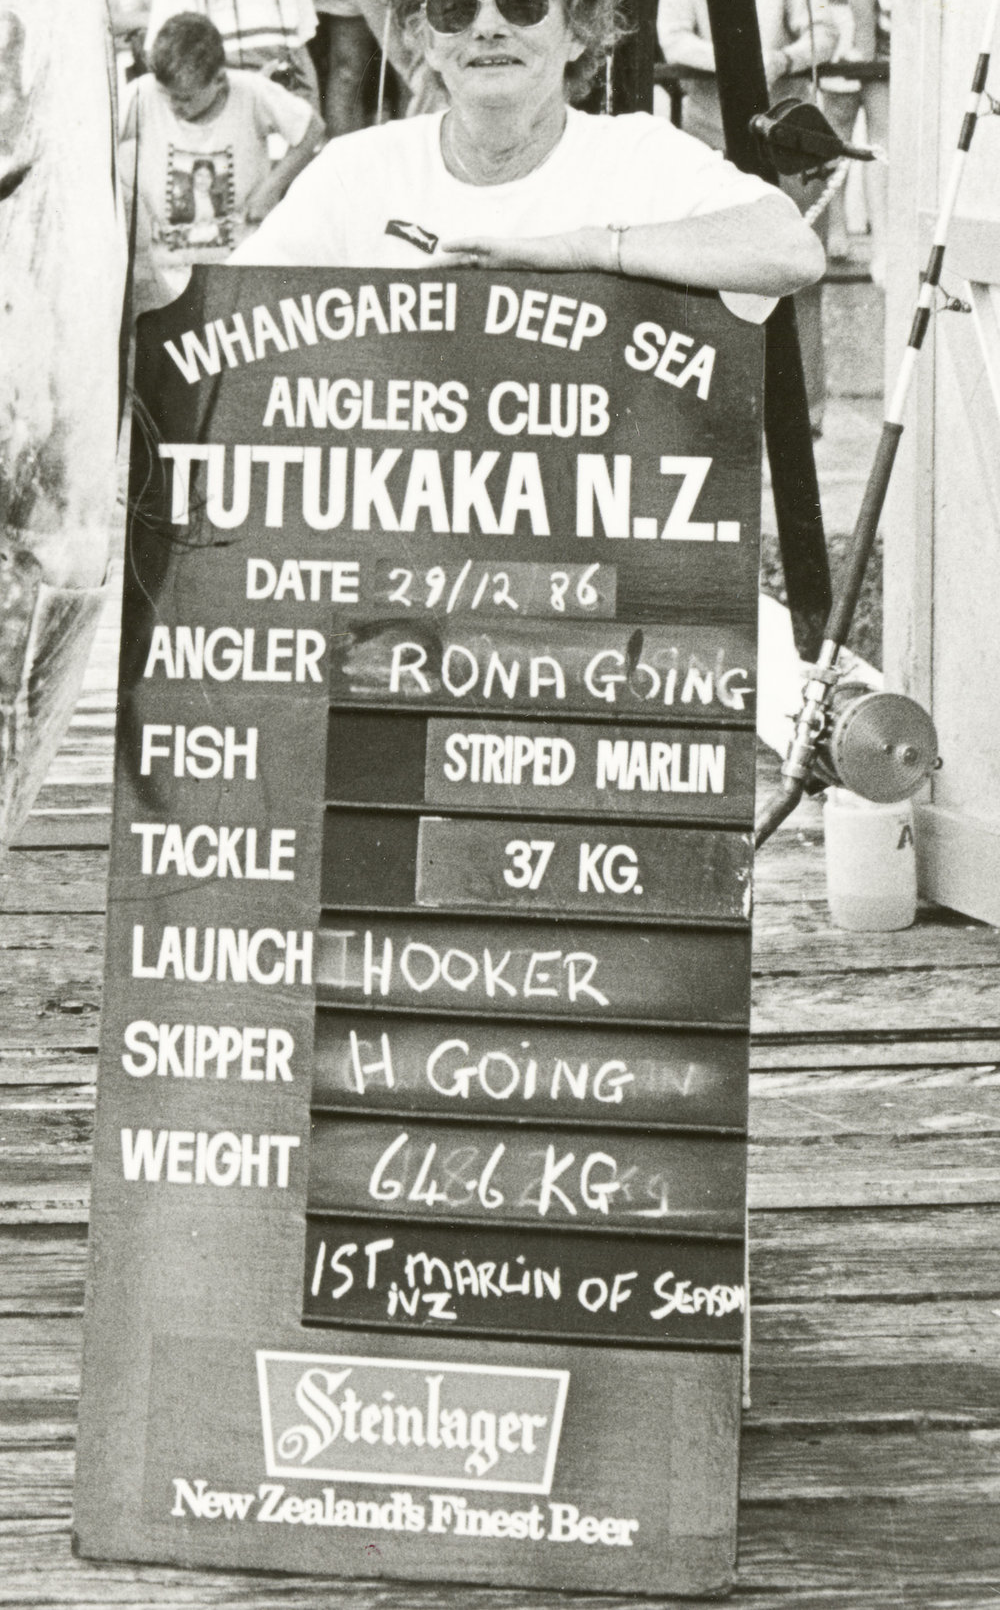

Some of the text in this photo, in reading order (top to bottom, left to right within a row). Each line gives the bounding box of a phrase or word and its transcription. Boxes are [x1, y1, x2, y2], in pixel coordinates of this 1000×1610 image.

[164, 282, 716, 400] WHANGAREI DEEP SEA
[262, 376, 610, 438] ANGLERS CLUB
[159, 444, 741, 543] TUTUKAKA N.Z.
[246, 558, 360, 603] DATE
[549, 563, 600, 612] 86
[144, 625, 326, 683] ANGLER
[388, 641, 566, 699] RONA
[140, 724, 258, 780] FISH
[443, 732, 726, 794] STRIPED MARLIN
[130, 822, 296, 881] TACKLE
[503, 840, 555, 890] 37
[131, 924, 314, 986] LAUNCH
[363, 930, 610, 1006] HOOKER
[121, 1019, 295, 1082] SKIPPER
[347, 1030, 396, 1095] H
[120, 1127, 301, 1191] WEIGHT
[534, 1144, 621, 1216] KG
[577, 1271, 638, 1312] OF
[277, 1367, 547, 1477] Steinlager
[170, 1477, 640, 1546] New Zealand's Finest Beer
